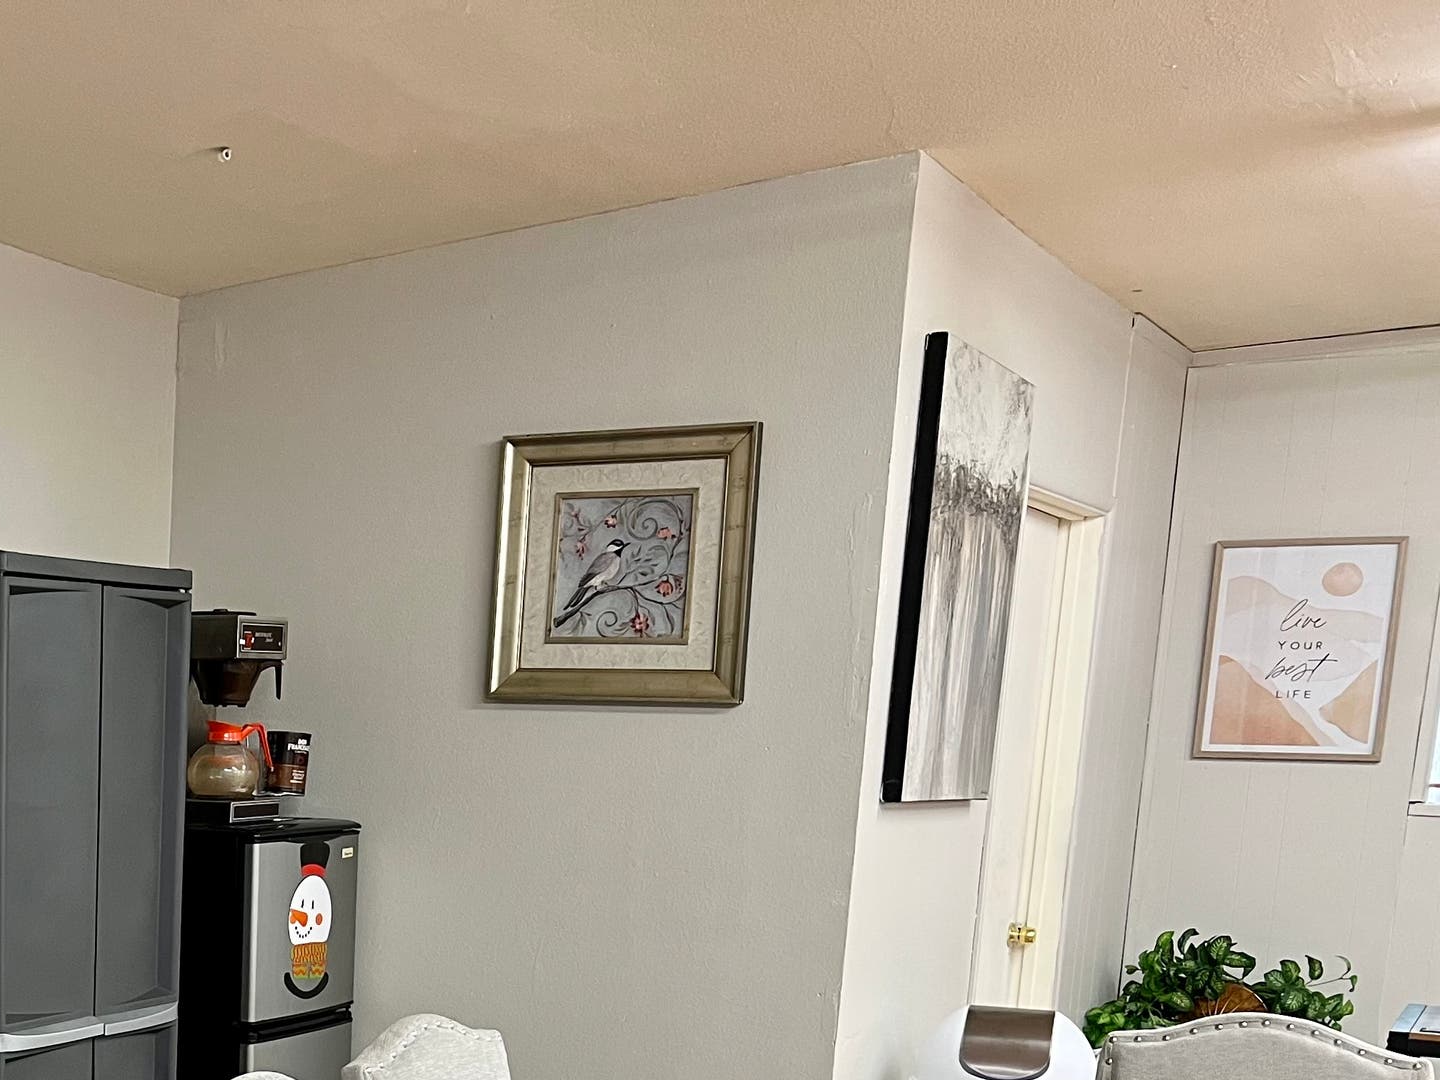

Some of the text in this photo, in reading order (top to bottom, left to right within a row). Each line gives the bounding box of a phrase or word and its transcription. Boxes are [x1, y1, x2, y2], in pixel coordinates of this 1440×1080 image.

[1279, 598, 1327, 632] live
[1278, 641, 1323, 650] YOUR
[1265, 653, 1338, 682] best
[1275, 690, 1312, 699] LIFE
